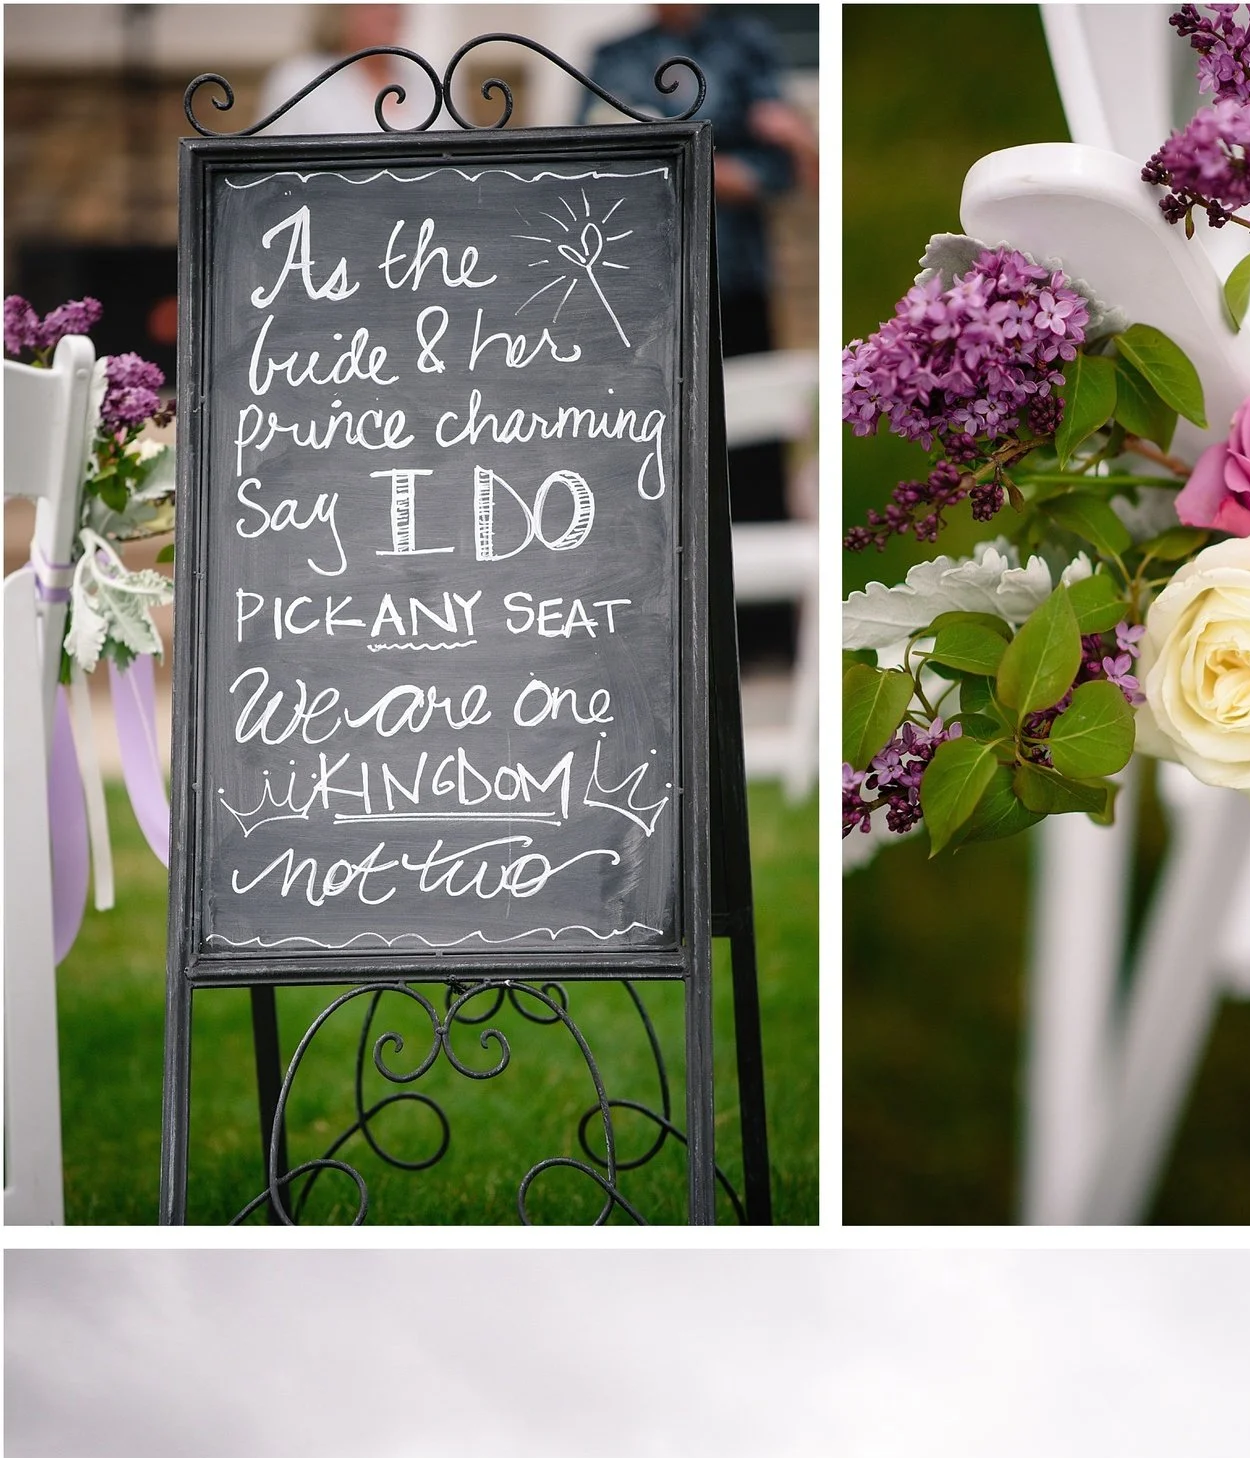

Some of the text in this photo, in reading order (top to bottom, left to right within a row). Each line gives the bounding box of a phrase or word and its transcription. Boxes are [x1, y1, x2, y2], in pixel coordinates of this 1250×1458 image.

[251, 205, 497, 307] As the
[249, 305, 581, 395] bride & her
[234, 389, 666, 500] prince charming
[235, 465, 596, 576] Say I DO
[237, 588, 631, 642] PICK ANY SEAT
[230, 667, 342, 745] We
[344, 684, 491, 737] are
[315, 747, 574, 819] KINGDOM
[232, 837, 620, 907] not two
